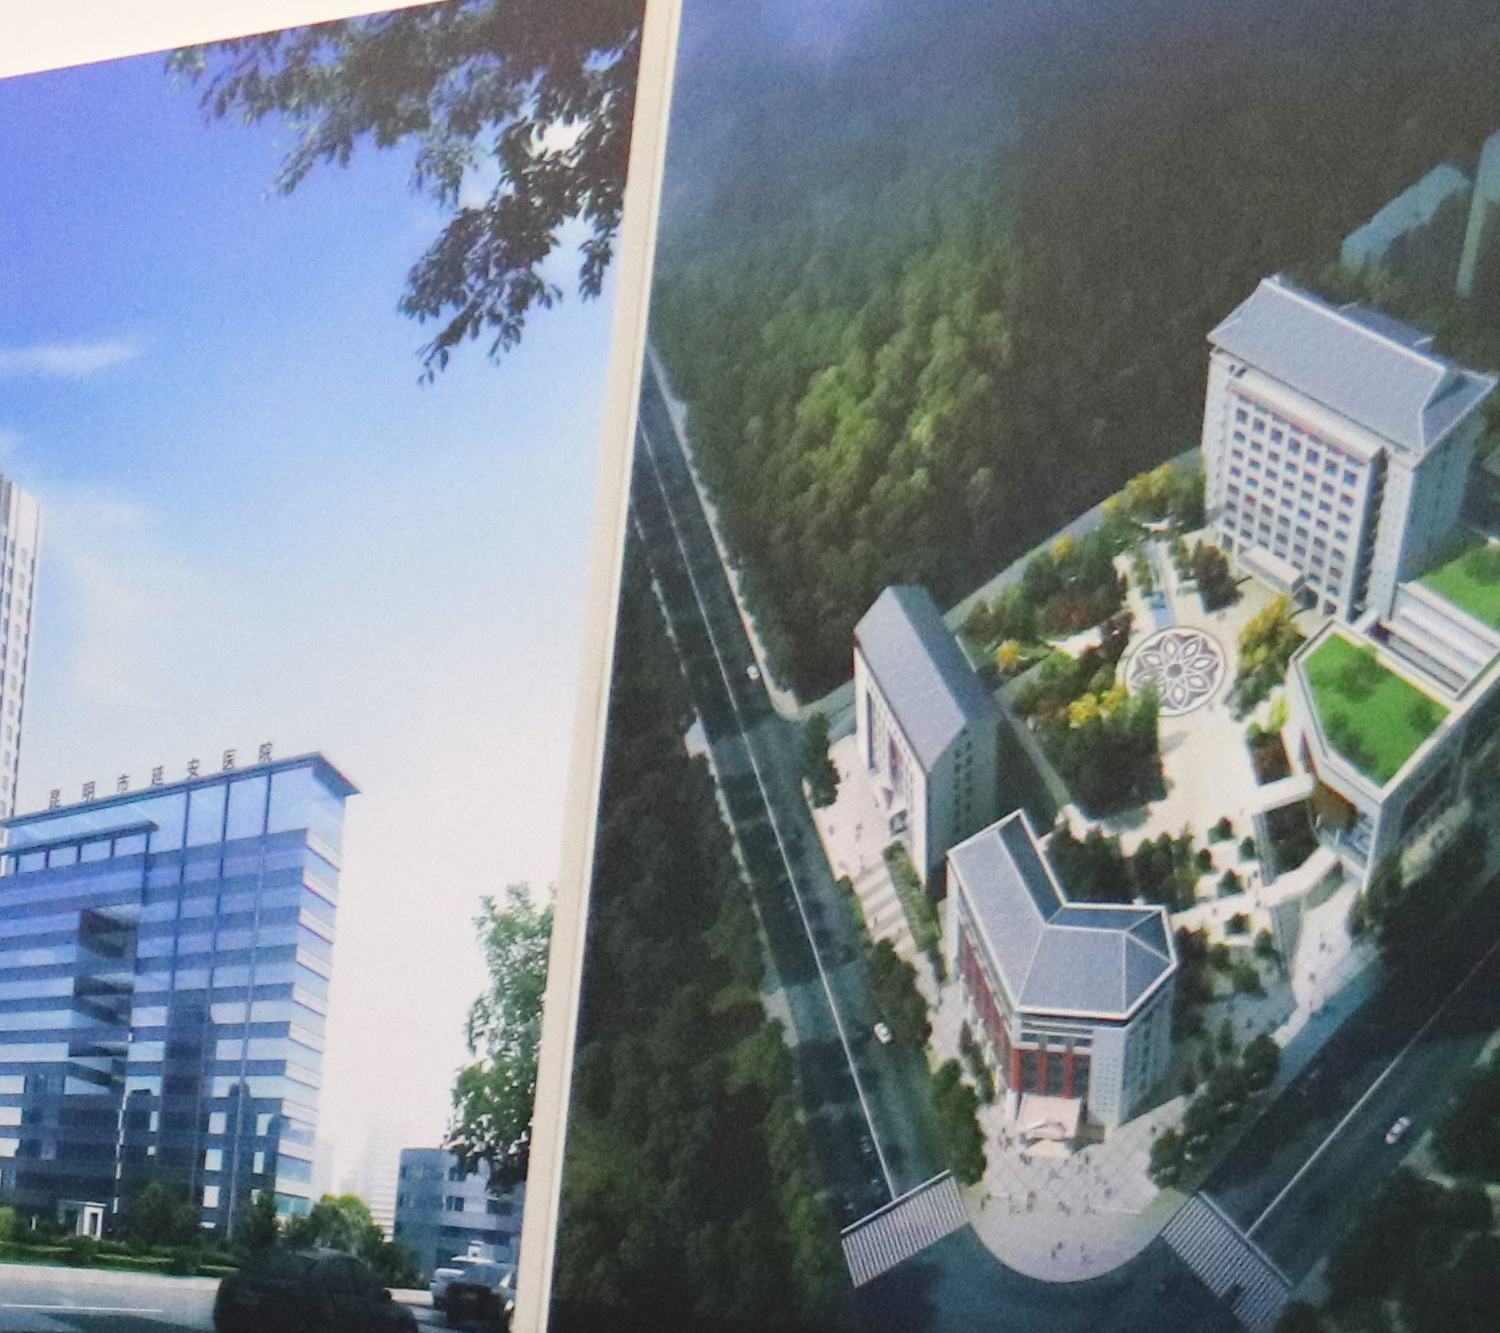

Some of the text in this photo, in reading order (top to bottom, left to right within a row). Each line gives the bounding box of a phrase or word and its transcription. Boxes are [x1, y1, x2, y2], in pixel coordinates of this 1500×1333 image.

[49, 741, 274, 809] 昆明市延安医院
